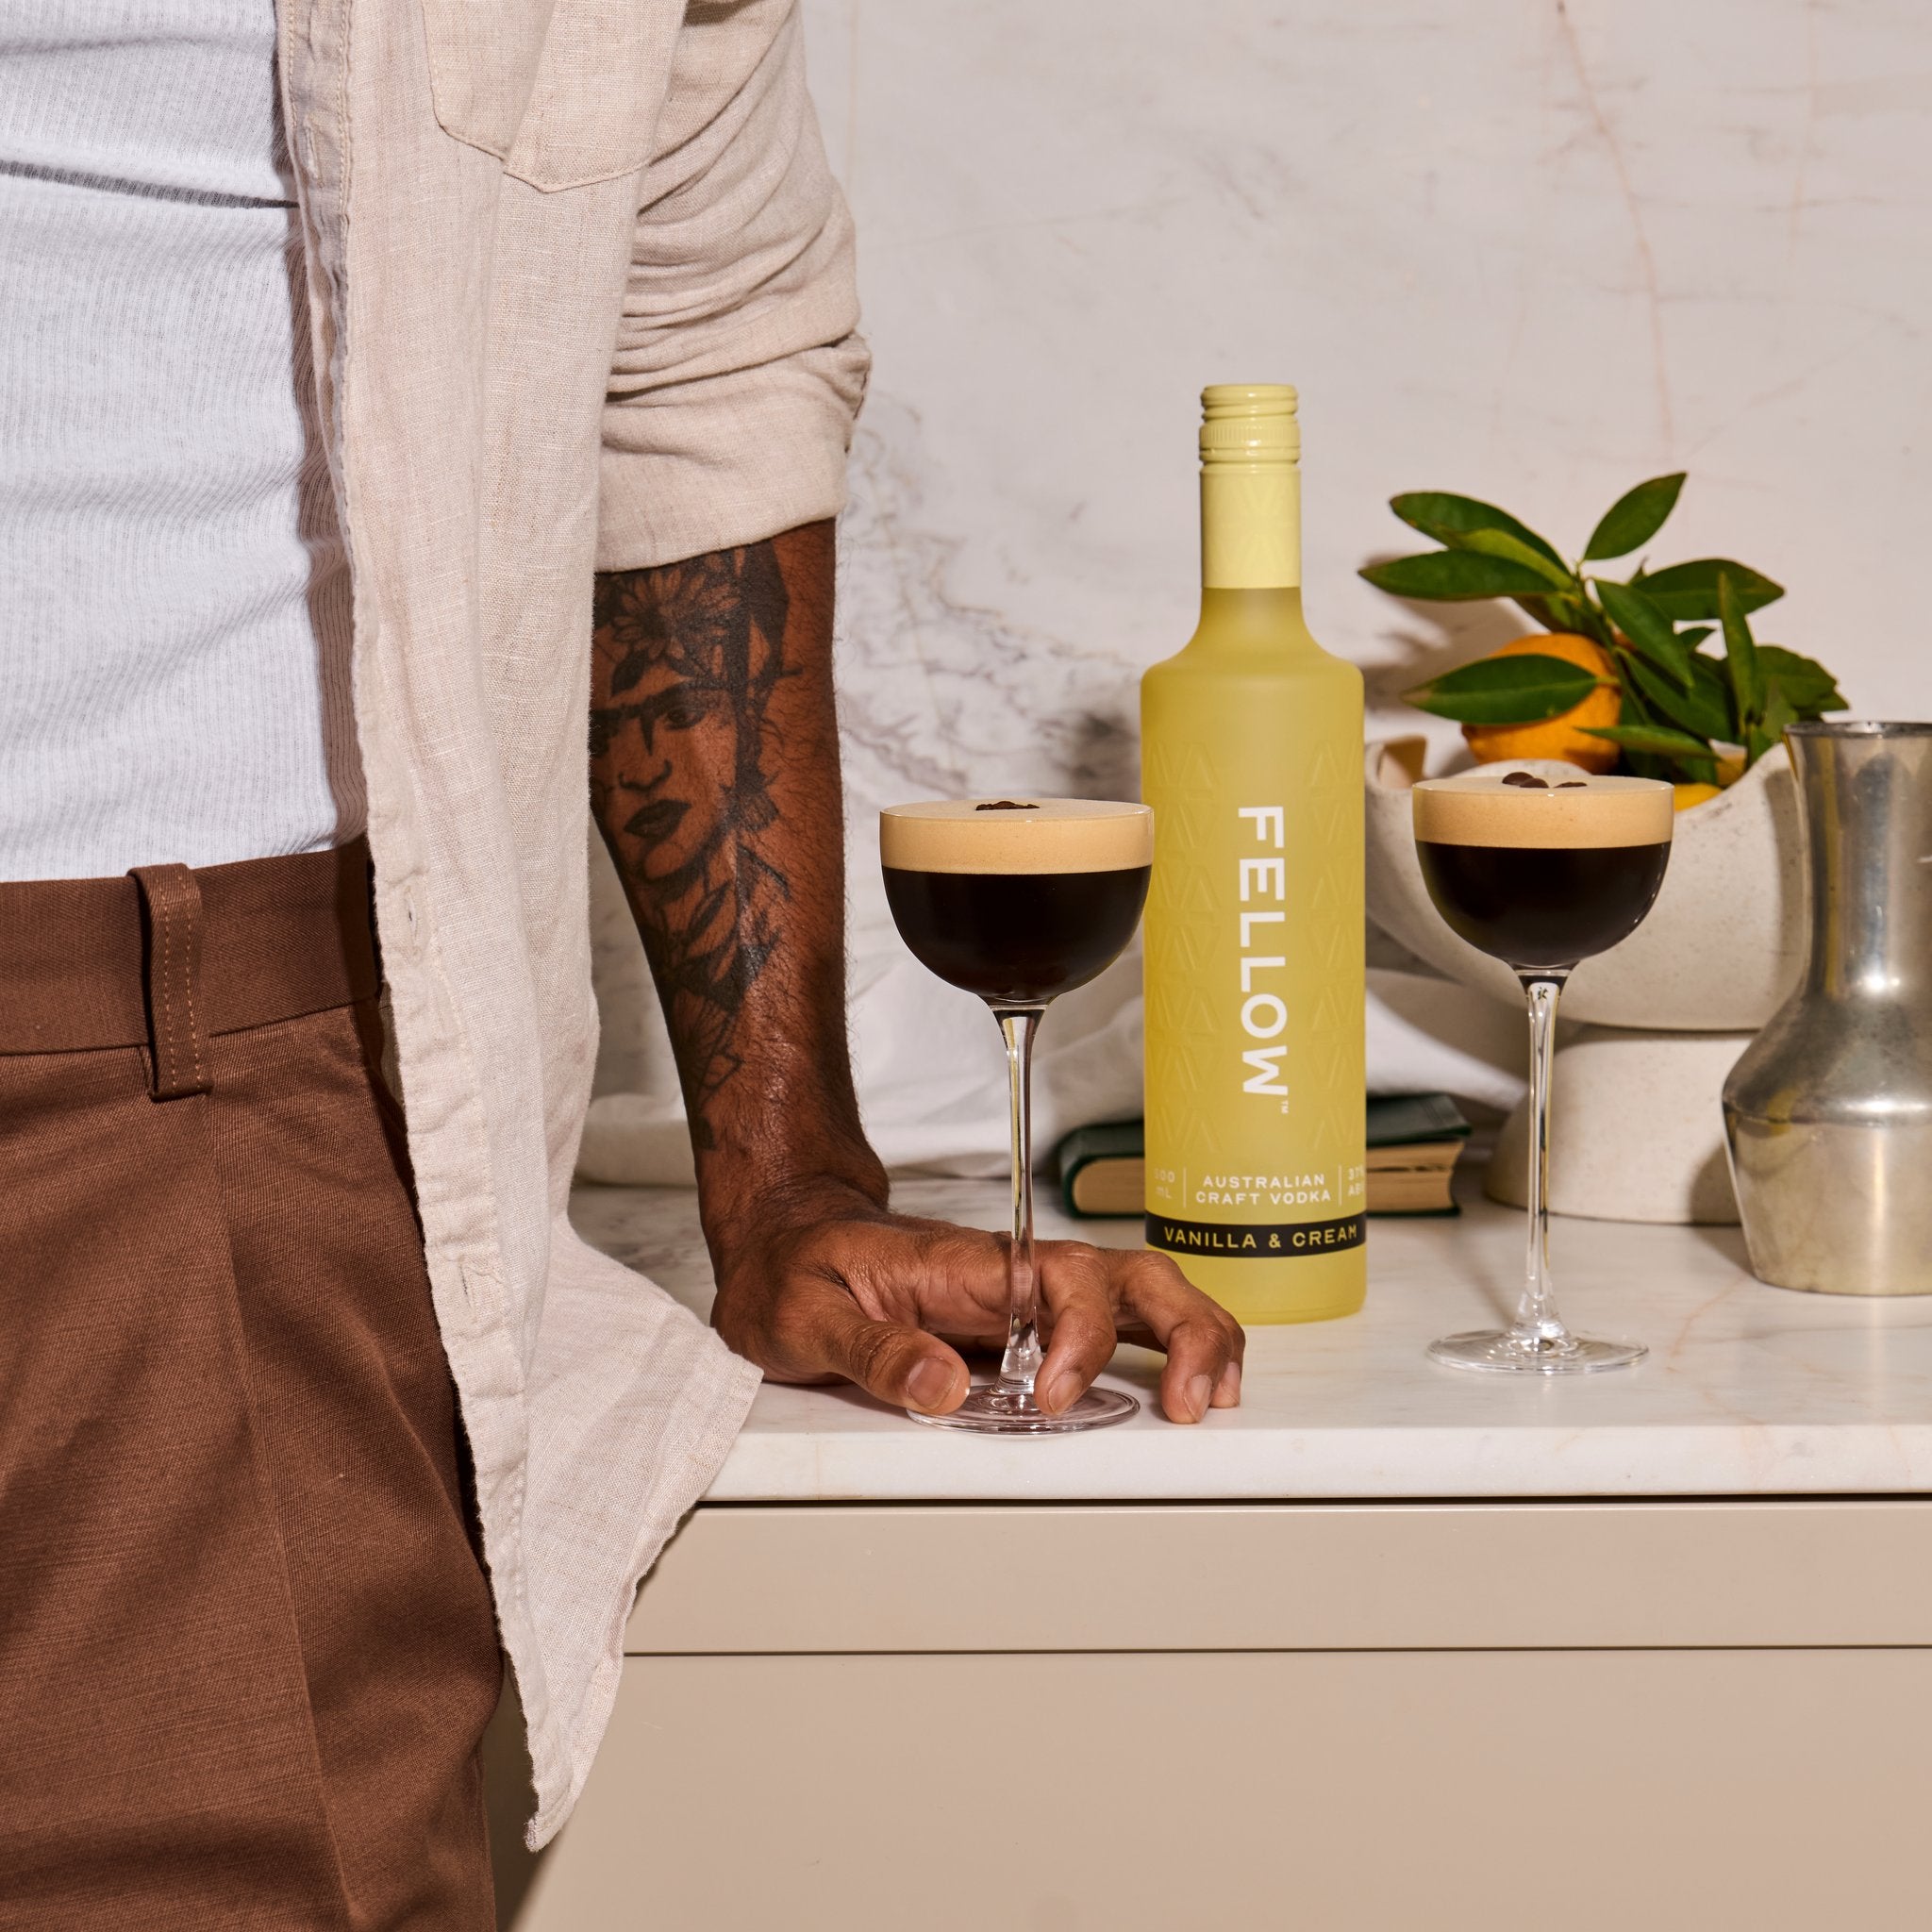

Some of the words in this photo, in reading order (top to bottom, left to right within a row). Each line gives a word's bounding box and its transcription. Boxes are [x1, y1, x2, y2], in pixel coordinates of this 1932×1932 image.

[1239, 806, 1289, 1096] FELLOW
[1203, 1174, 1324, 1189] AUSTRALIAN
[1195, 1191, 1260, 1206] CRAFT
[1270, 1190, 1331, 1205] VODKA
[1164, 1225, 1257, 1249] VANILLA
[1269, 1235, 1281, 1248] &
[1292, 1224, 1357, 1248] CREAM
